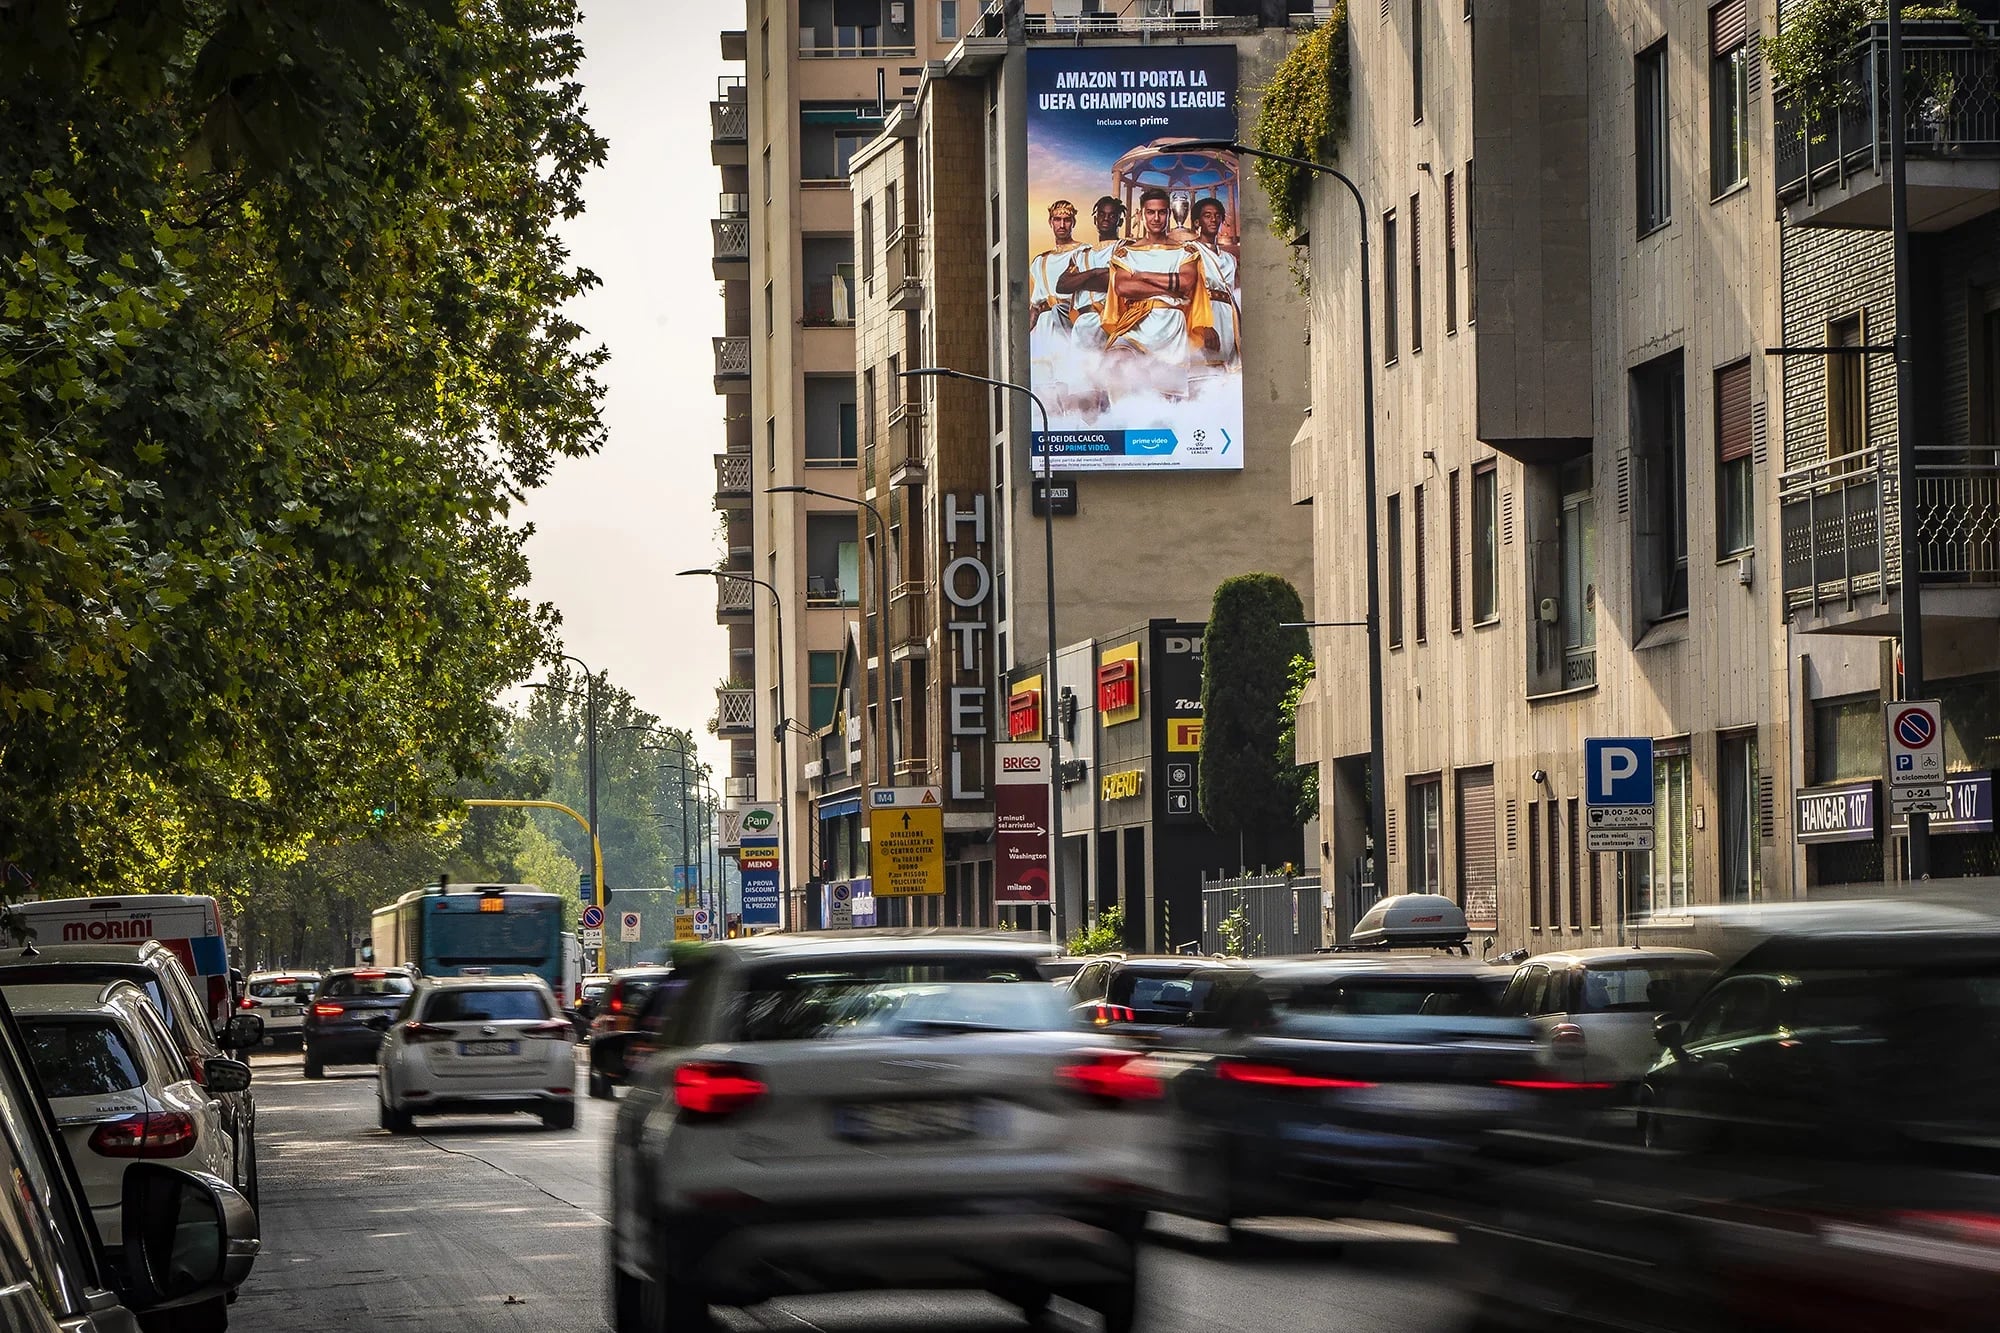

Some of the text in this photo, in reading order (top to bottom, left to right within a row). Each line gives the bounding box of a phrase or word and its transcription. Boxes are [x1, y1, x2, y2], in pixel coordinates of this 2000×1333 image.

[1056, 70, 1208, 89] AMAZON TI PORTA LA
[1039, 91, 1226, 110] UEFA CHAMPIONS LEAGUE
[1096, 118, 1122, 126] Inclusa
[1140, 116, 1169, 127] prime
[1037, 434, 1106, 443] GI DEI DEL CALCIO,
[1038, 444, 1053, 452] LIE
[1054, 444, 1065, 452] SU
[1065, 444, 1087, 452] PRIME
[943, 494, 990, 799] HOTEL
[1003, 757, 1041, 769] BRICO
[1600, 747, 1638, 796] P
[1902, 773, 1940, 781] ciclomotori
[1907, 789, 1931, 798] 0-24
[1958, 784, 1978, 818] 107
[1802, 799, 1847, 831] HANGAR
[1850, 794, 1868, 827] 107
[747, 817, 769, 826] Pam
[1008, 821, 1036, 829] arrivato!
[747, 860, 773, 868] MENO
[63, 919, 152, 942] MORINI
